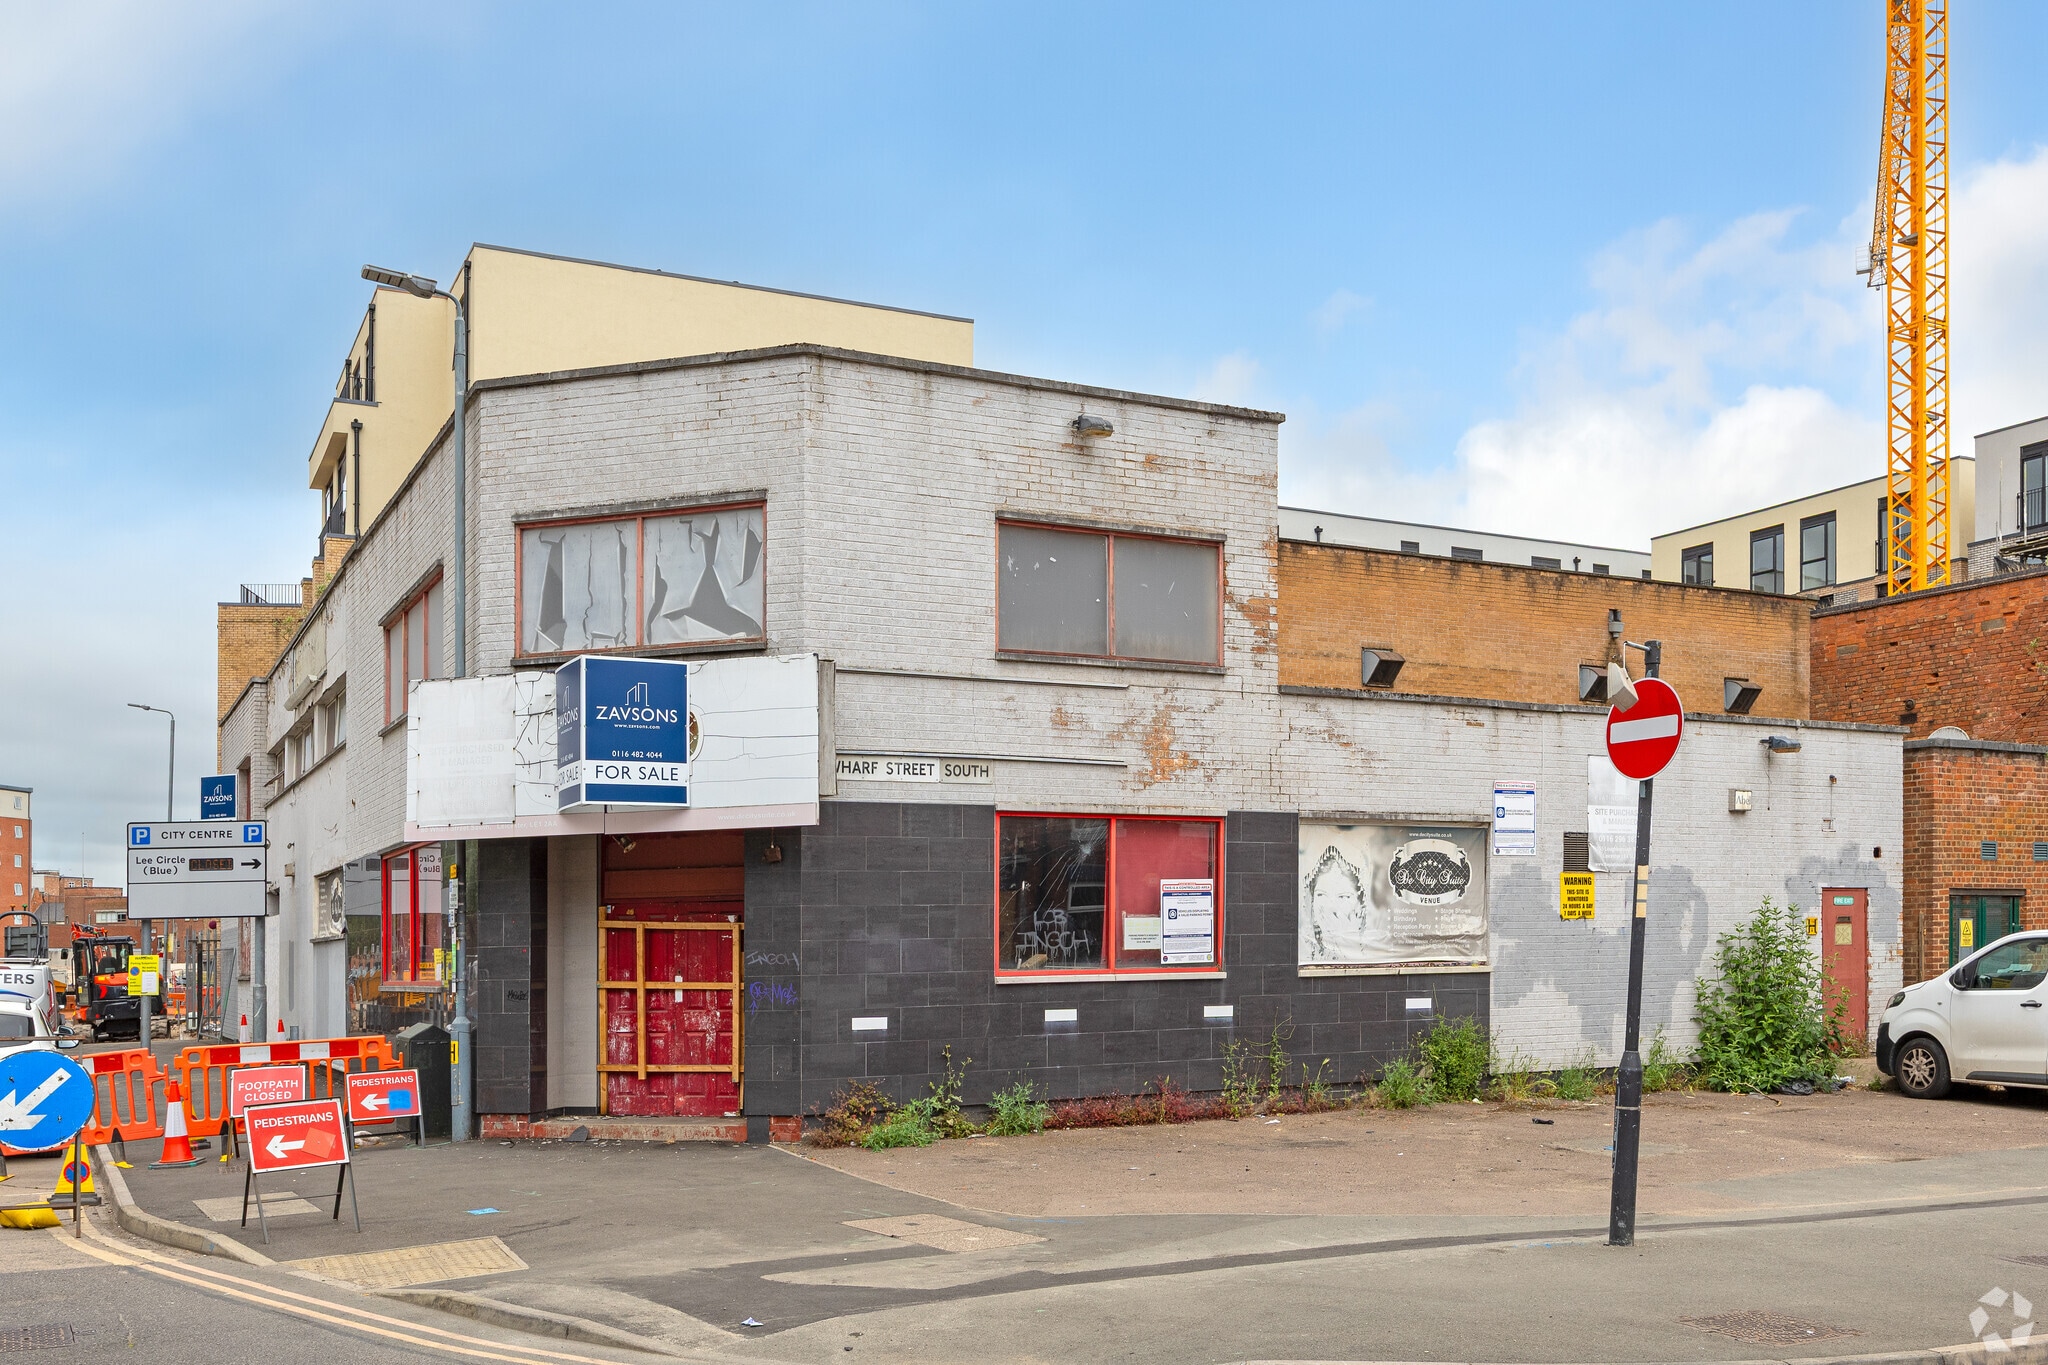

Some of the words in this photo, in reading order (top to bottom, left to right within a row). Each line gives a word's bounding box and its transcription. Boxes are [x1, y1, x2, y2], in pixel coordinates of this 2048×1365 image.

[596, 706, 678, 723] ZAVSONS
[612, 750, 629, 758] 0116
[645, 751, 663, 759] 4044
[595, 765, 631, 780] FOR
[638, 766, 679, 781] SALE
[836, 761, 878, 775] HARF
[886, 762, 935, 776] STREET
[945, 764, 989, 778] SOUTH
[203, 794, 233, 803] ZAVSONS
[161, 831, 185, 840] CITY
[189, 830, 232, 839] CENTRE
[136, 856, 153, 865] Lee
[156, 855, 186, 864] Circle
[1395, 868, 1414, 885] De
[1416, 869, 1437, 888] City
[1438, 868, 1466, 885] Suite
[1564, 877, 1592, 885] WARNING
[238, 1080, 299, 1092] FOOTPATH
[351, 1075, 414, 1087] PEDESTRIANS
[244, 1091, 292, 1102] CLOSED
[254, 1112, 334, 1129] PEDESTRIANS
